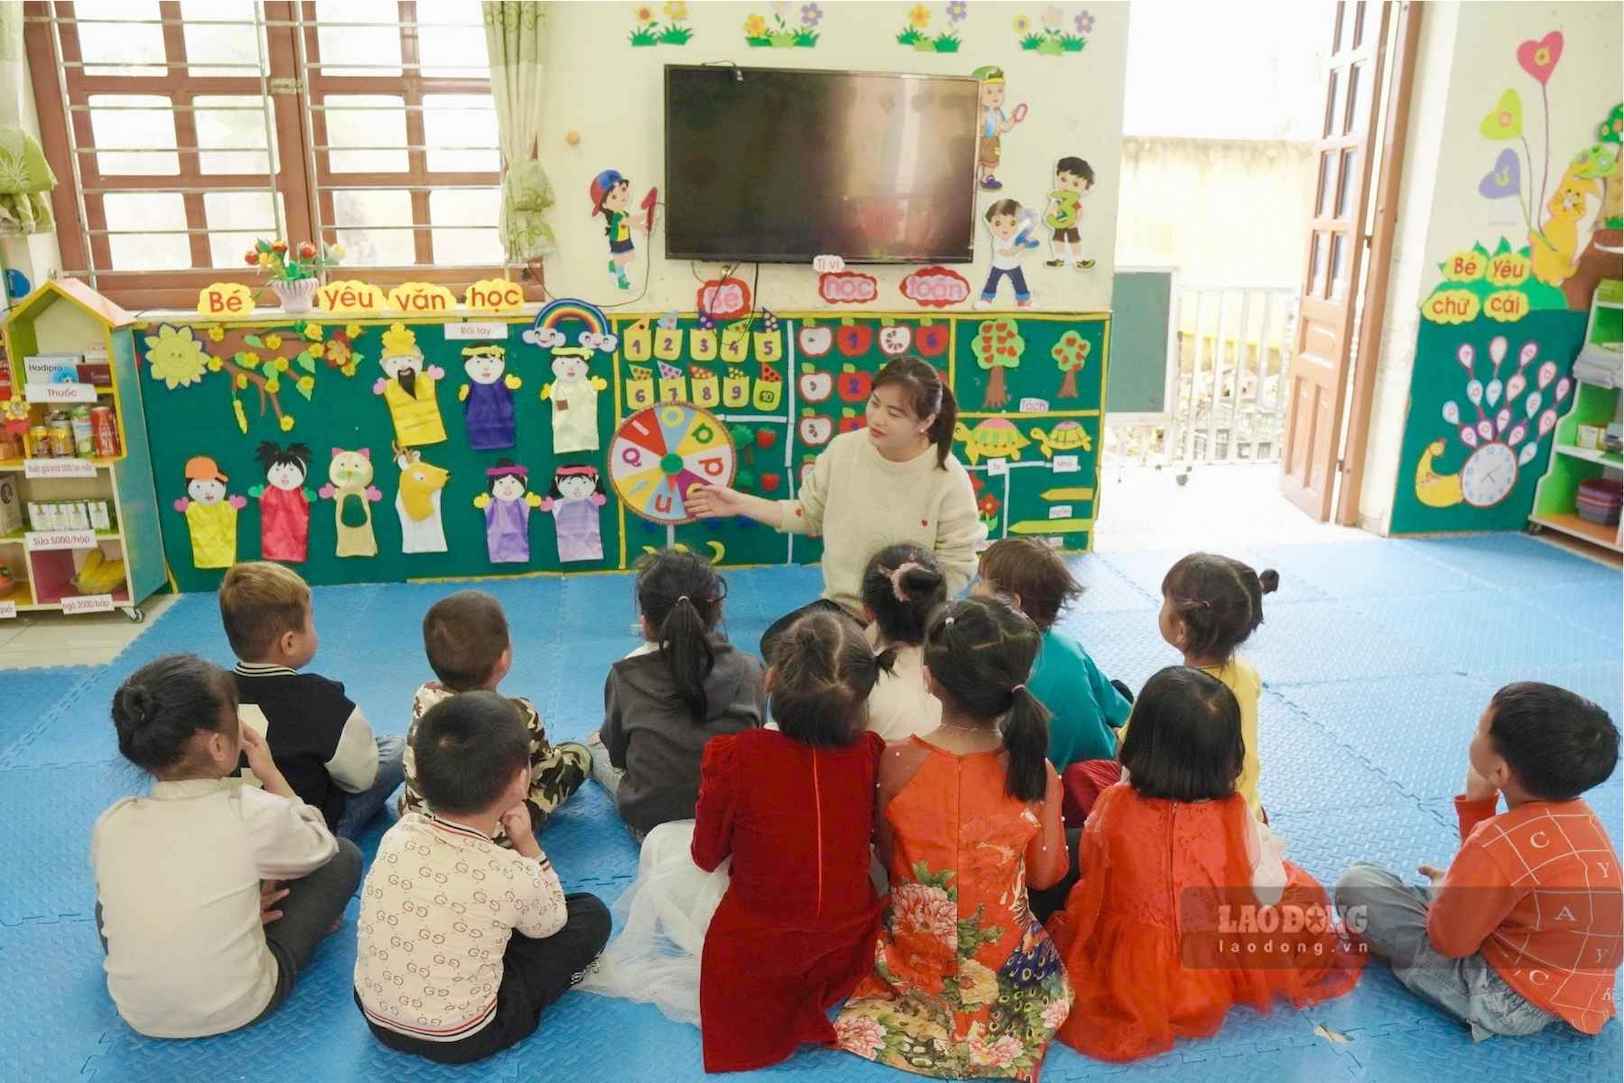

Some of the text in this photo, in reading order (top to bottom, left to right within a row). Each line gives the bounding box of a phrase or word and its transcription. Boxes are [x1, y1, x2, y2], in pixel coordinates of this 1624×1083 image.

[1454, 255, 1477, 275] Bé
[208, 286, 520, 313] Bé yêu văn học
[1490, 294, 1520, 314] cái
[632, 339, 641, 354] 1
[663, 337, 673, 352] 2
[700, 338, 708, 353] 3
[729, 340, 738, 354] 4
[763, 341, 772, 355] 5
[635, 389, 645, 403] 6
[668, 387, 678, 403] 7
[702, 386, 712, 400] 8
[732, 385, 741, 400] 9
[760, 391, 774, 403] 10
[1530, 831, 1550, 848] C
[1554, 906, 1576, 921] A
